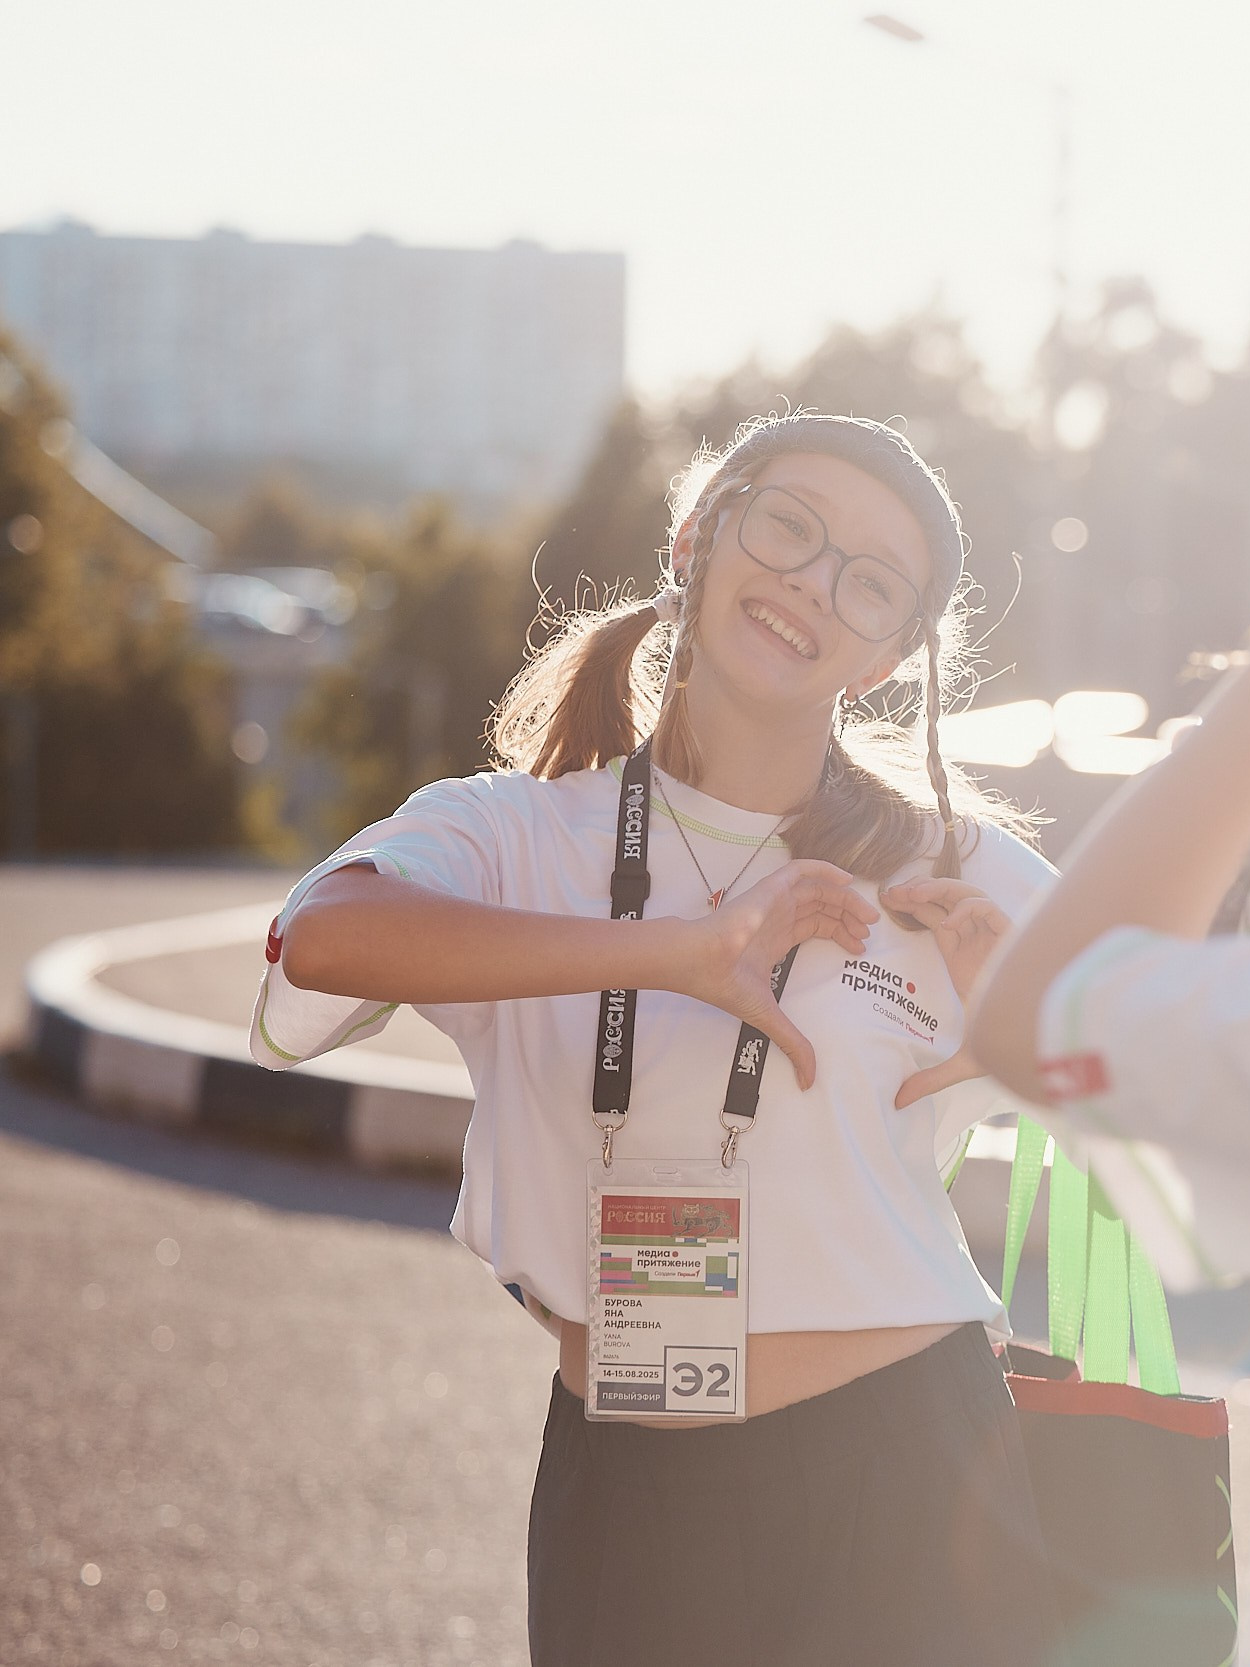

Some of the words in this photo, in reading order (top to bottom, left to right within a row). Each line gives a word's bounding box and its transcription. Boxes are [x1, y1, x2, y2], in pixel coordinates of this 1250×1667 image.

[623, 783, 645, 860] РОССИЯ
[844, 960, 903, 988] медиа
[841, 973, 938, 1031] притяжение
[872, 1002, 904, 1028] Создали
[607, 1210, 666, 1224] РОССИЯ
[637, 1250, 671, 1258] медиа
[637, 1259, 701, 1268] притяжение
[604, 1299, 643, 1307] БУРОВА
[604, 1309, 624, 1318] ЯНА
[604, 1320, 662, 1329] АНДРЕЕВНА
[602, 1369, 660, 1379] 14-15.08.2025
[671, 1362, 731, 1397] Э2
[602, 1391, 661, 1401] ПЕРВЫЙЭФИР
